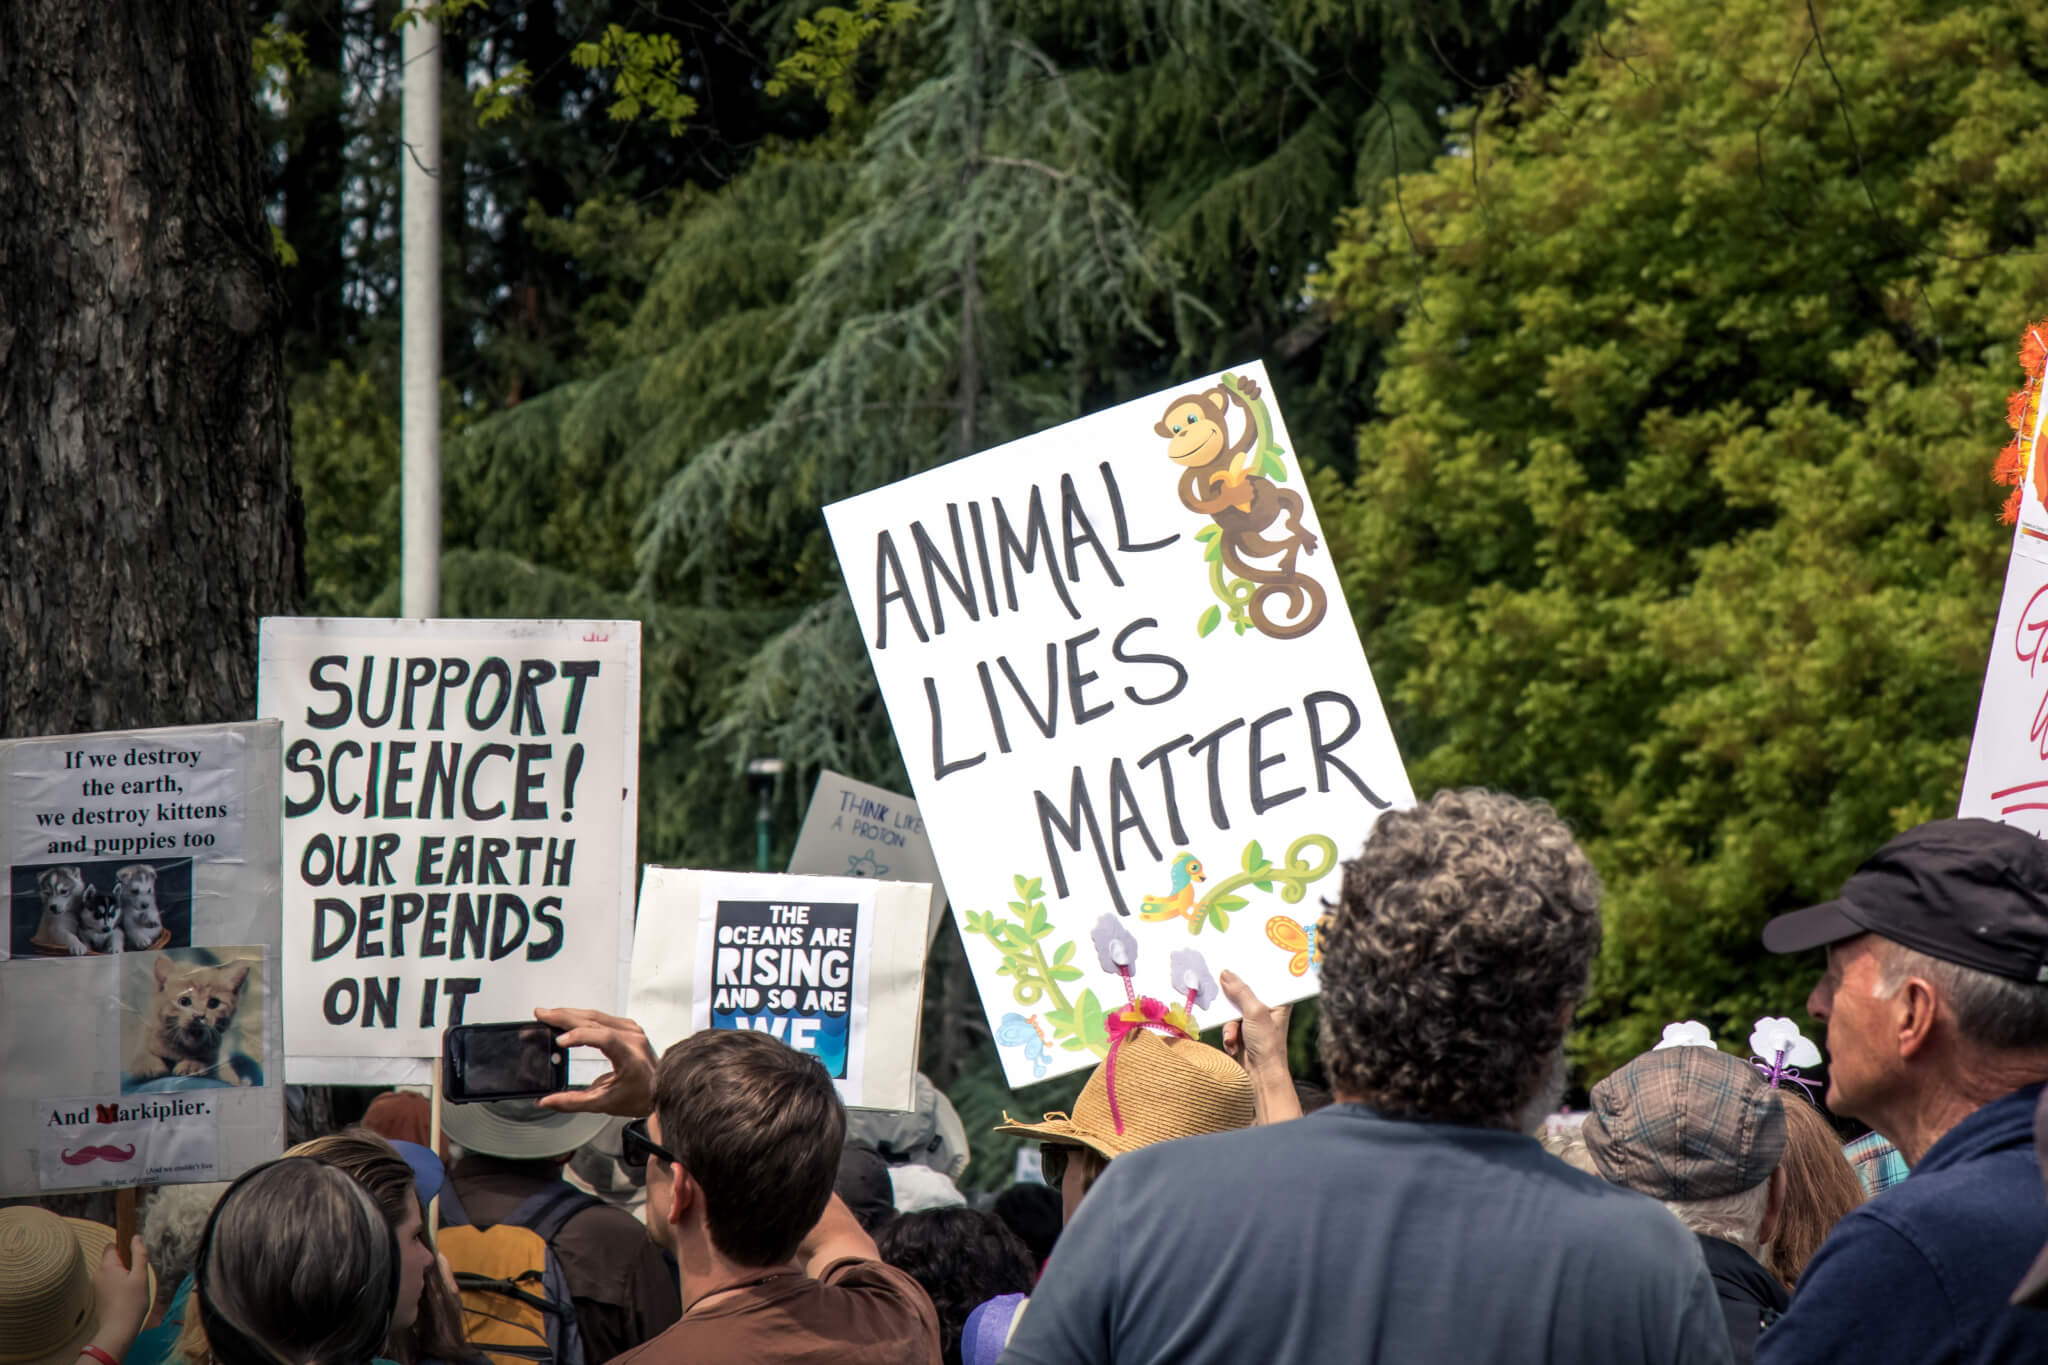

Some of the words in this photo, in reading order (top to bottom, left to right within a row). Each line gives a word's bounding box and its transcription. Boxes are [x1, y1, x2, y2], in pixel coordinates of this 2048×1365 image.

[875, 461, 1180, 650] ANIMAL
[306, 655, 601, 736] SUPPORT
[923, 617, 1188, 781] LIVES
[64, 751, 84, 769] If
[88, 753, 117, 768] we
[124, 748, 202, 768] destroy
[82, 779, 115, 796] the
[121, 775, 183, 796] earth,
[285, 738, 585, 823] SCIENCE!
[36, 812, 65, 827] we
[72, 807, 150, 827] destroy
[157, 803, 228, 822] kittens
[840, 790, 890, 822] THINK
[894, 811, 922, 834] LIKE
[1033, 690, 1391, 917] MATTER
[48, 835, 87, 854] and
[93, 832, 176, 856] puppies
[184, 831, 216, 848] too
[831, 815, 843, 832] A
[852, 819, 906, 848] PROTON
[301, 833, 400, 887] OUR
[415, 835, 576, 886] EARTH
[311, 893, 564, 962] DEPENDS
[769, 905, 810, 925] THE
[718, 926, 803, 946] OCEANS
[809, 927, 851, 948] ARE
[716, 948, 850, 988] RISING
[323, 976, 400, 1028] ON
[419, 977, 482, 1028] IT
[714, 988, 760, 1010] AND
[768, 989, 797, 1010] SO
[802, 991, 847, 1012] ARE
[48, 1107, 90, 1127] And
[96, 1100, 211, 1124] Markiplier.
